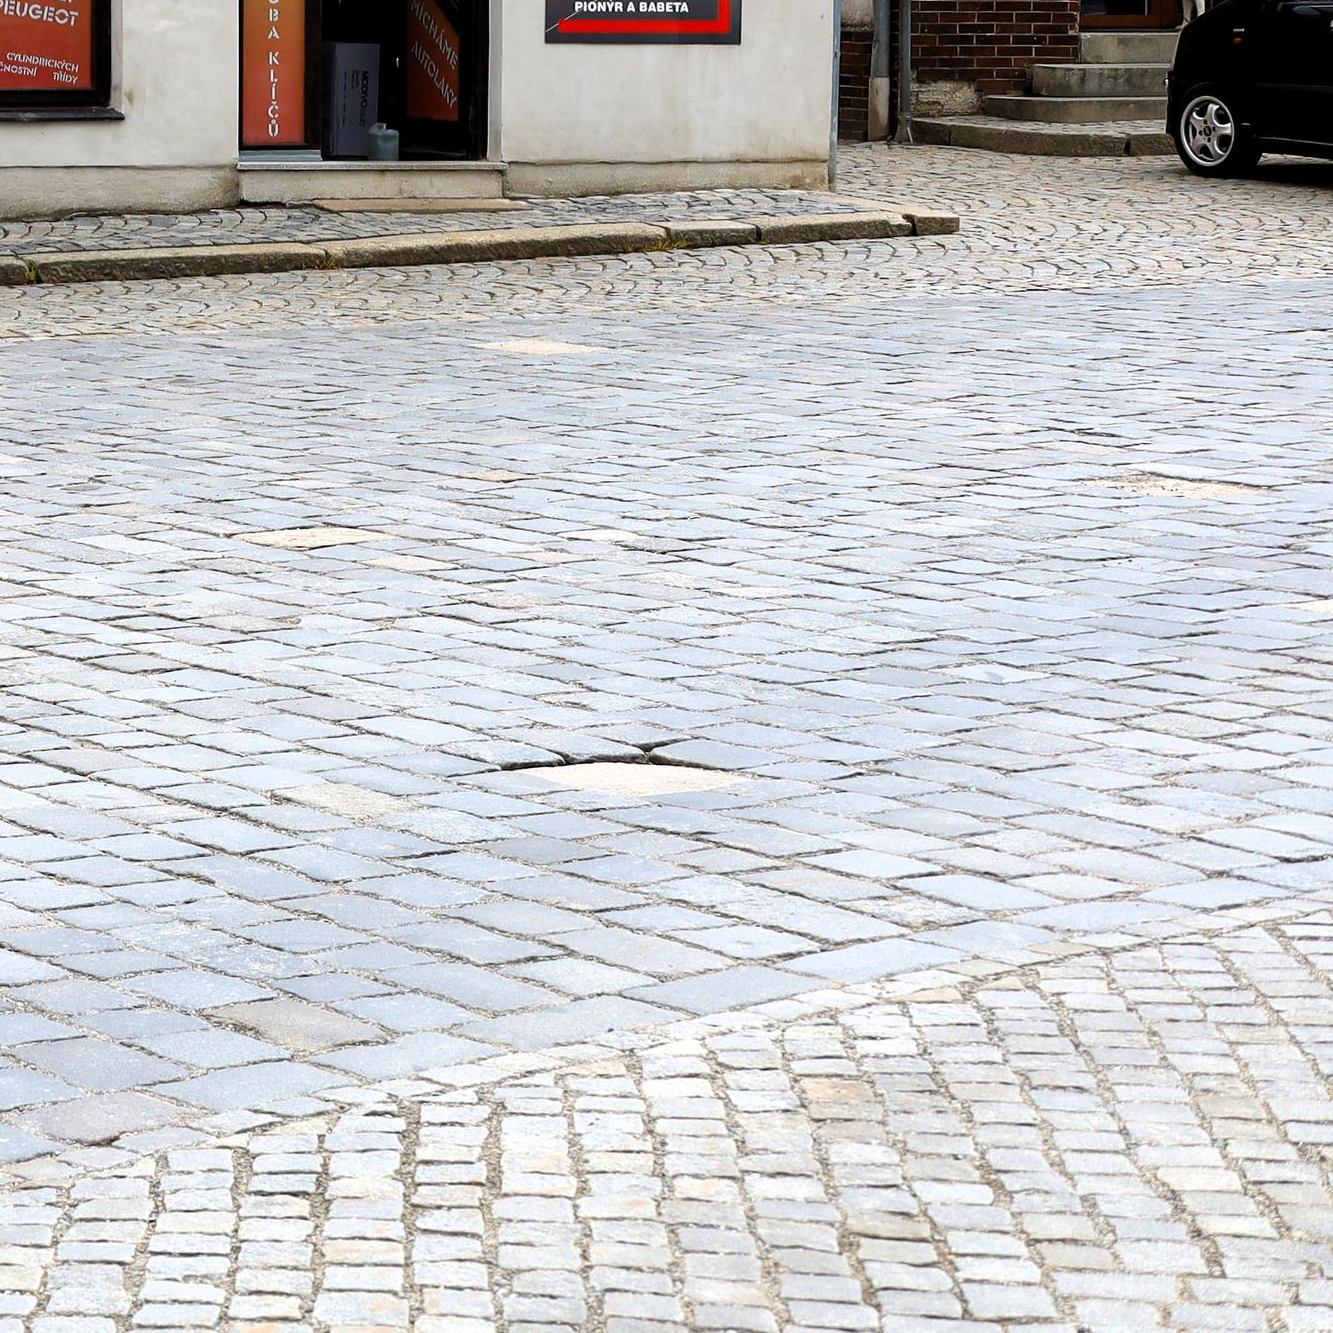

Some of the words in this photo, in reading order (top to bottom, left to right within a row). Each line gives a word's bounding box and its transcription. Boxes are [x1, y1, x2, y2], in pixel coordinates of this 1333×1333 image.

[626, 1, 636, 12] A
[639, 1, 689, 13] BABETA
[6, 51, 80, 73] CYLINDRICKÝCH
[52, 70, 78, 84] TŘÍDY
[411, 41, 458, 108] AUTOLAKY
[267, 51, 280, 138] KLÍČŮ
